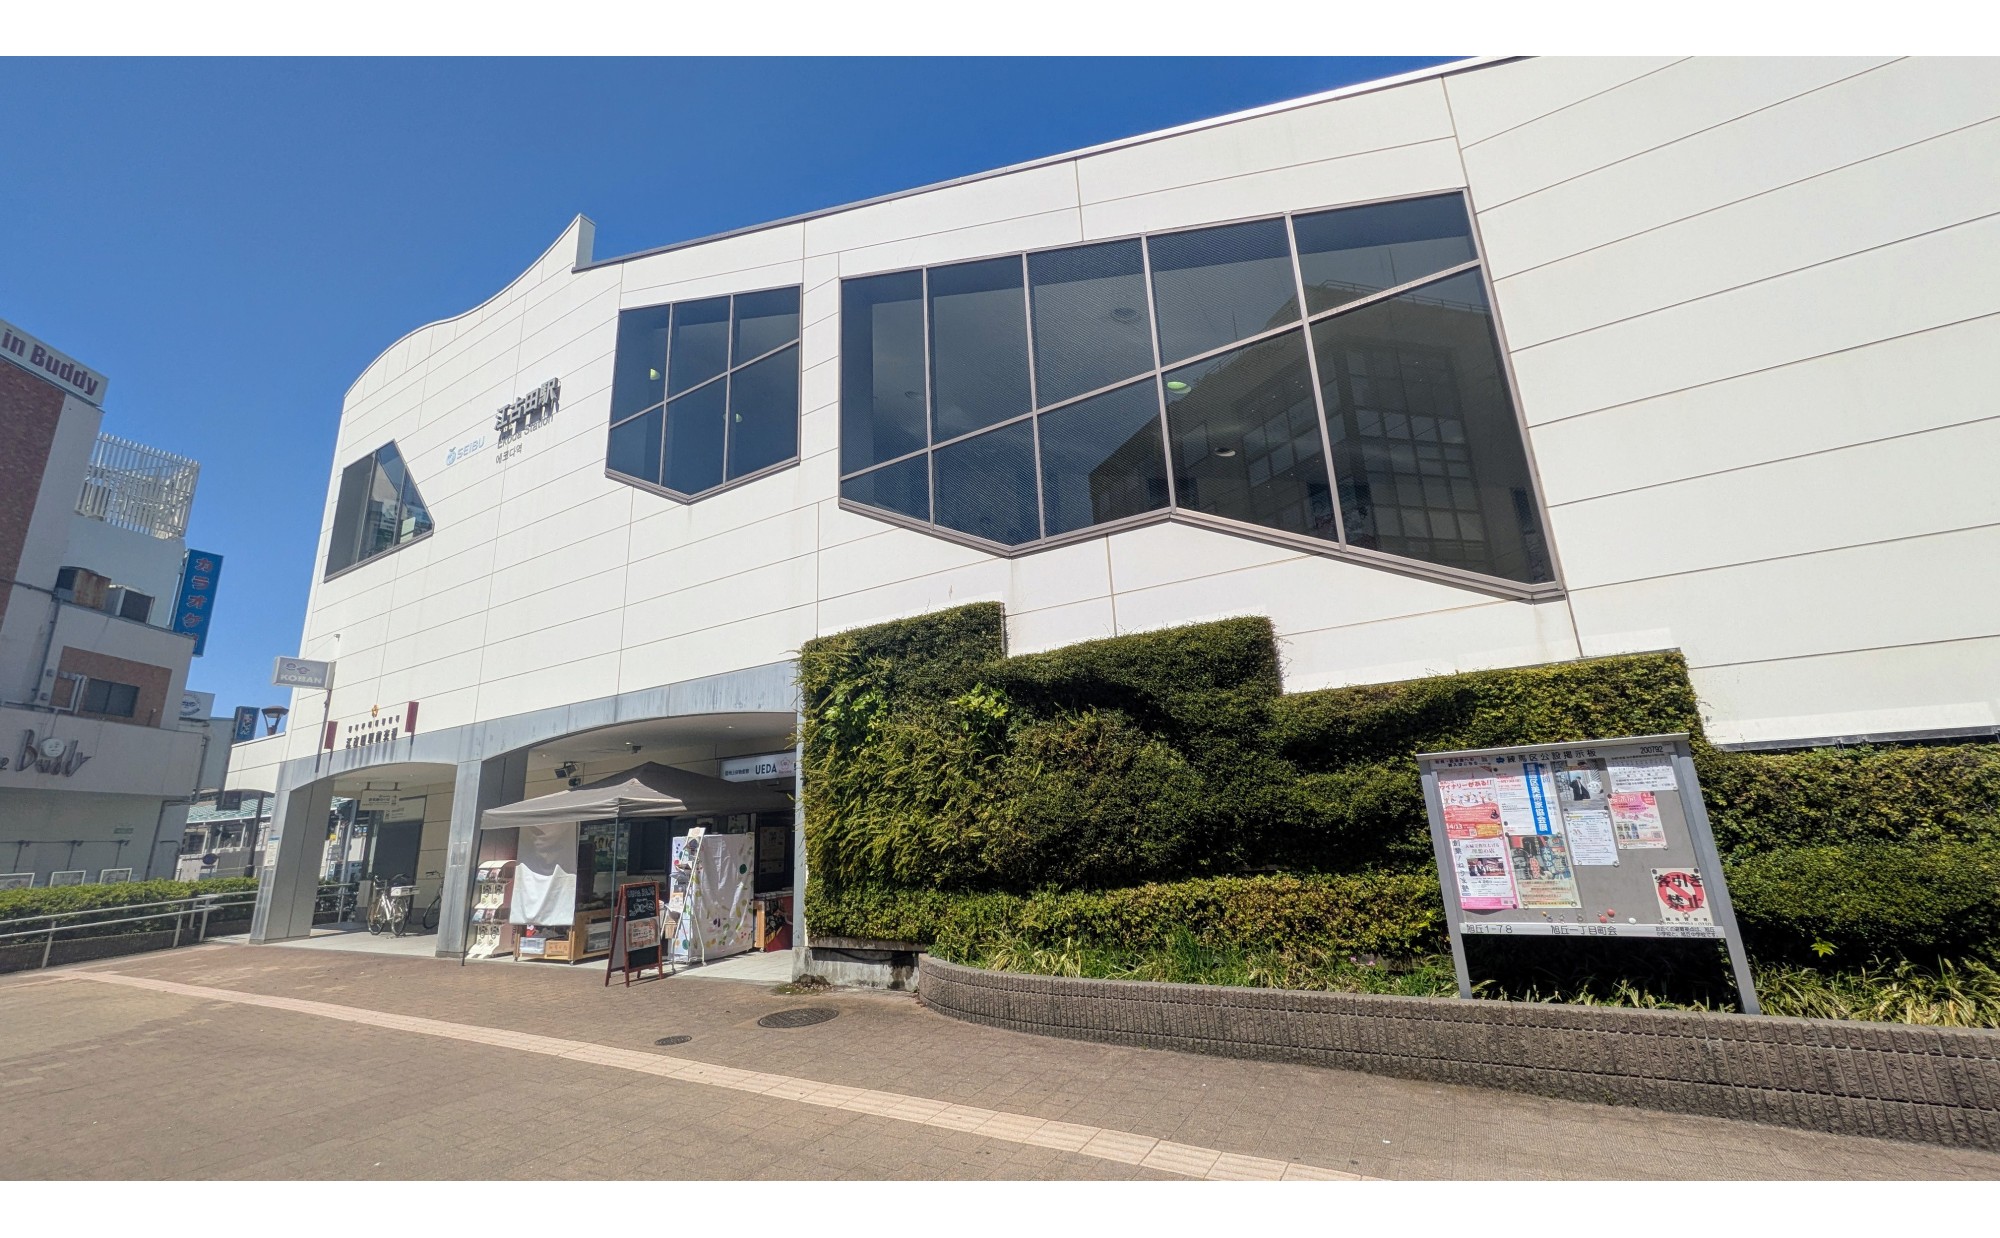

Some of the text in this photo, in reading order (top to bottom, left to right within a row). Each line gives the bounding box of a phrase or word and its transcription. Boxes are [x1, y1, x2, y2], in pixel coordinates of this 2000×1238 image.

[2, 328, 99, 396] in Buddy
[494, 376, 561, 431] 江古田駅
[497, 414, 554, 449] Ekoda Station
[456, 436, 486, 460] SEIBU
[495, 442, 523, 464] 에코다역
[280, 673, 323, 684] KOBAN
[1506, 748, 1597, 764] 練馬区公設掲示板
[1640, 745, 1664, 754] 200792
[755, 763, 778, 775] UEDA
[1654, 873, 1704, 888] 客引き
[1667, 894, 1705, 909] 禁止
[1550, 925, 1618, 936] 旭丘一丁目町会
